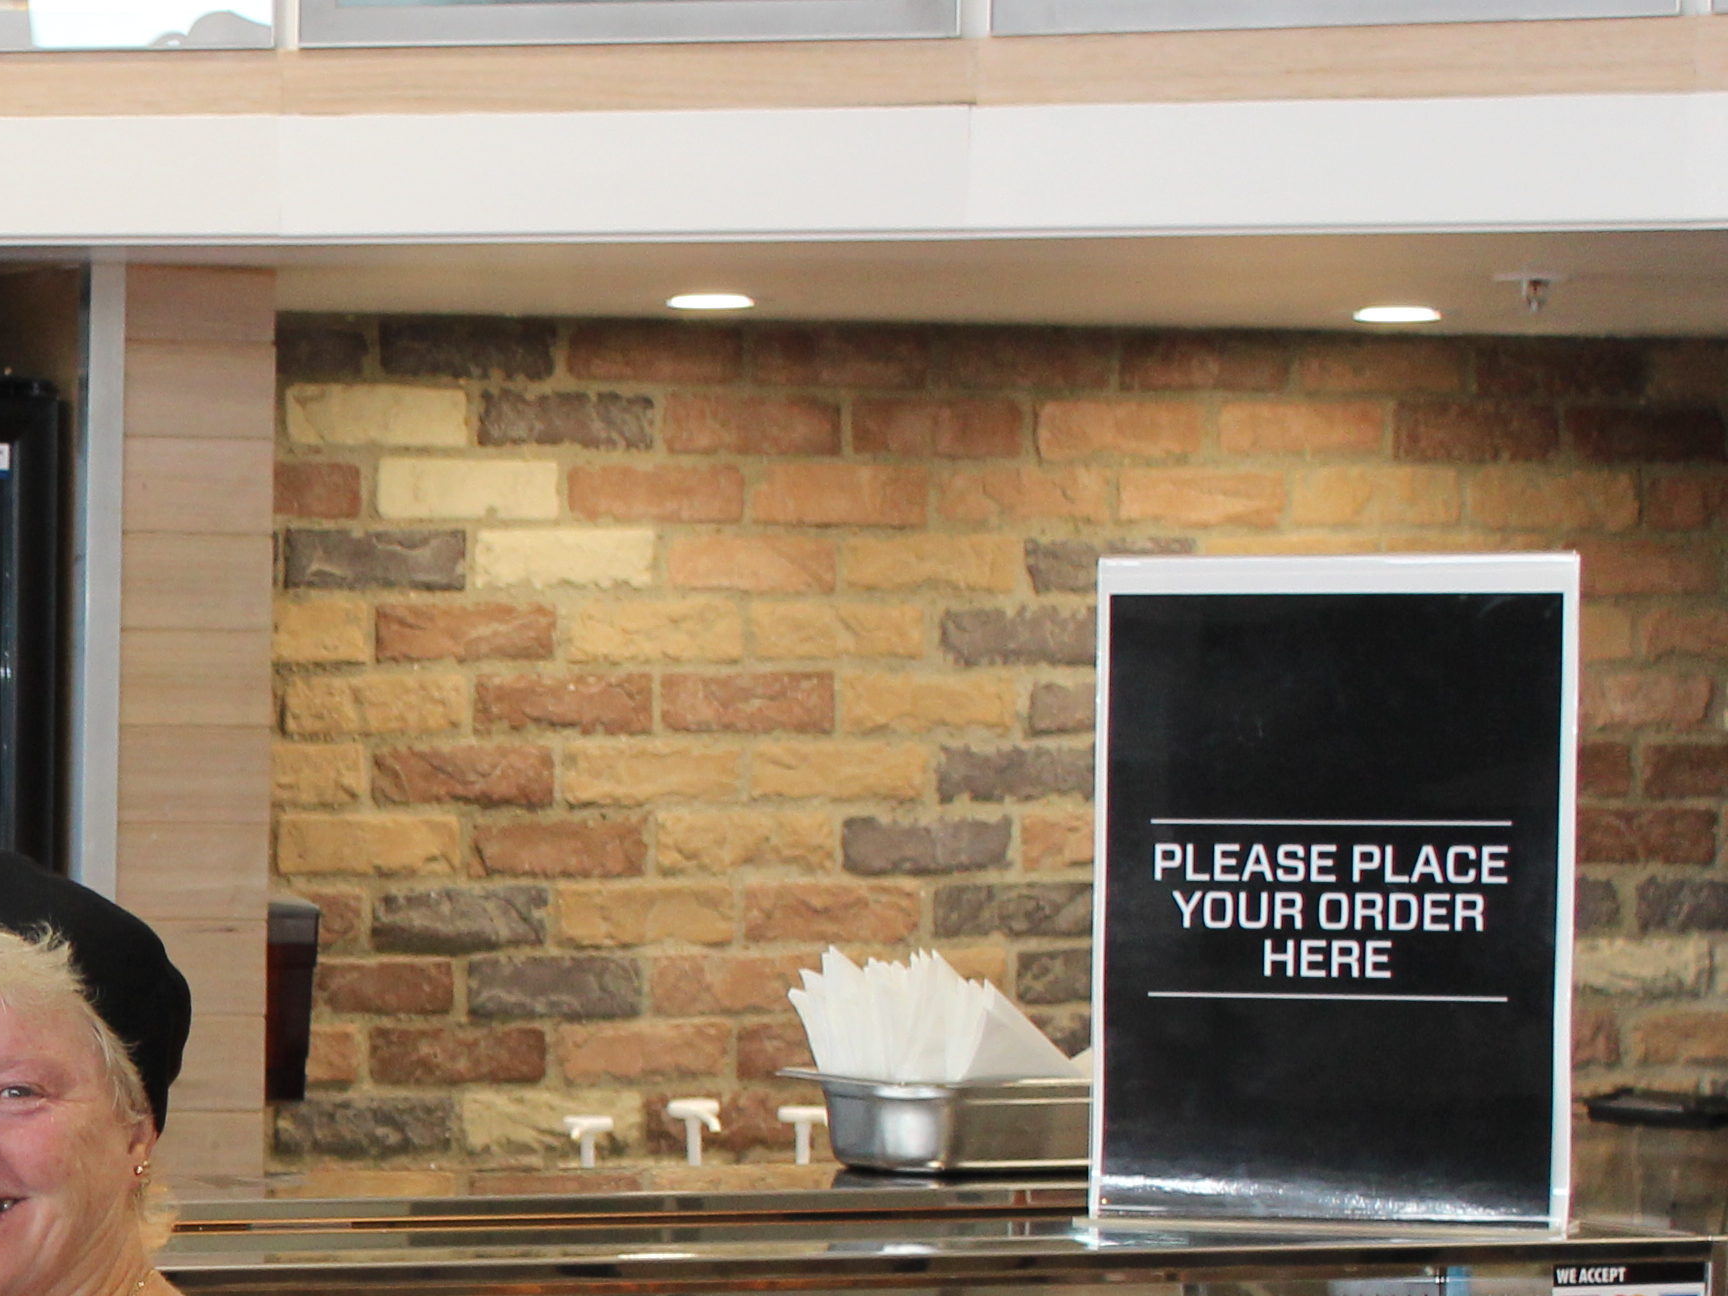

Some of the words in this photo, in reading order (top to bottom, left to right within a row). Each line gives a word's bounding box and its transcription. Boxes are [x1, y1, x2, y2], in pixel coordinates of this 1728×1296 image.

[1152, 843, 1337, 884] PLEASE
[1352, 844, 1509, 885] PLACE
[1172, 891, 1304, 931] YOUR
[1318, 892, 1485, 933] ORDER
[1263, 939, 1392, 979] HERE
[1556, 1268, 1577, 1284] WE
[1578, 1266, 1626, 1283] ACCEPT
